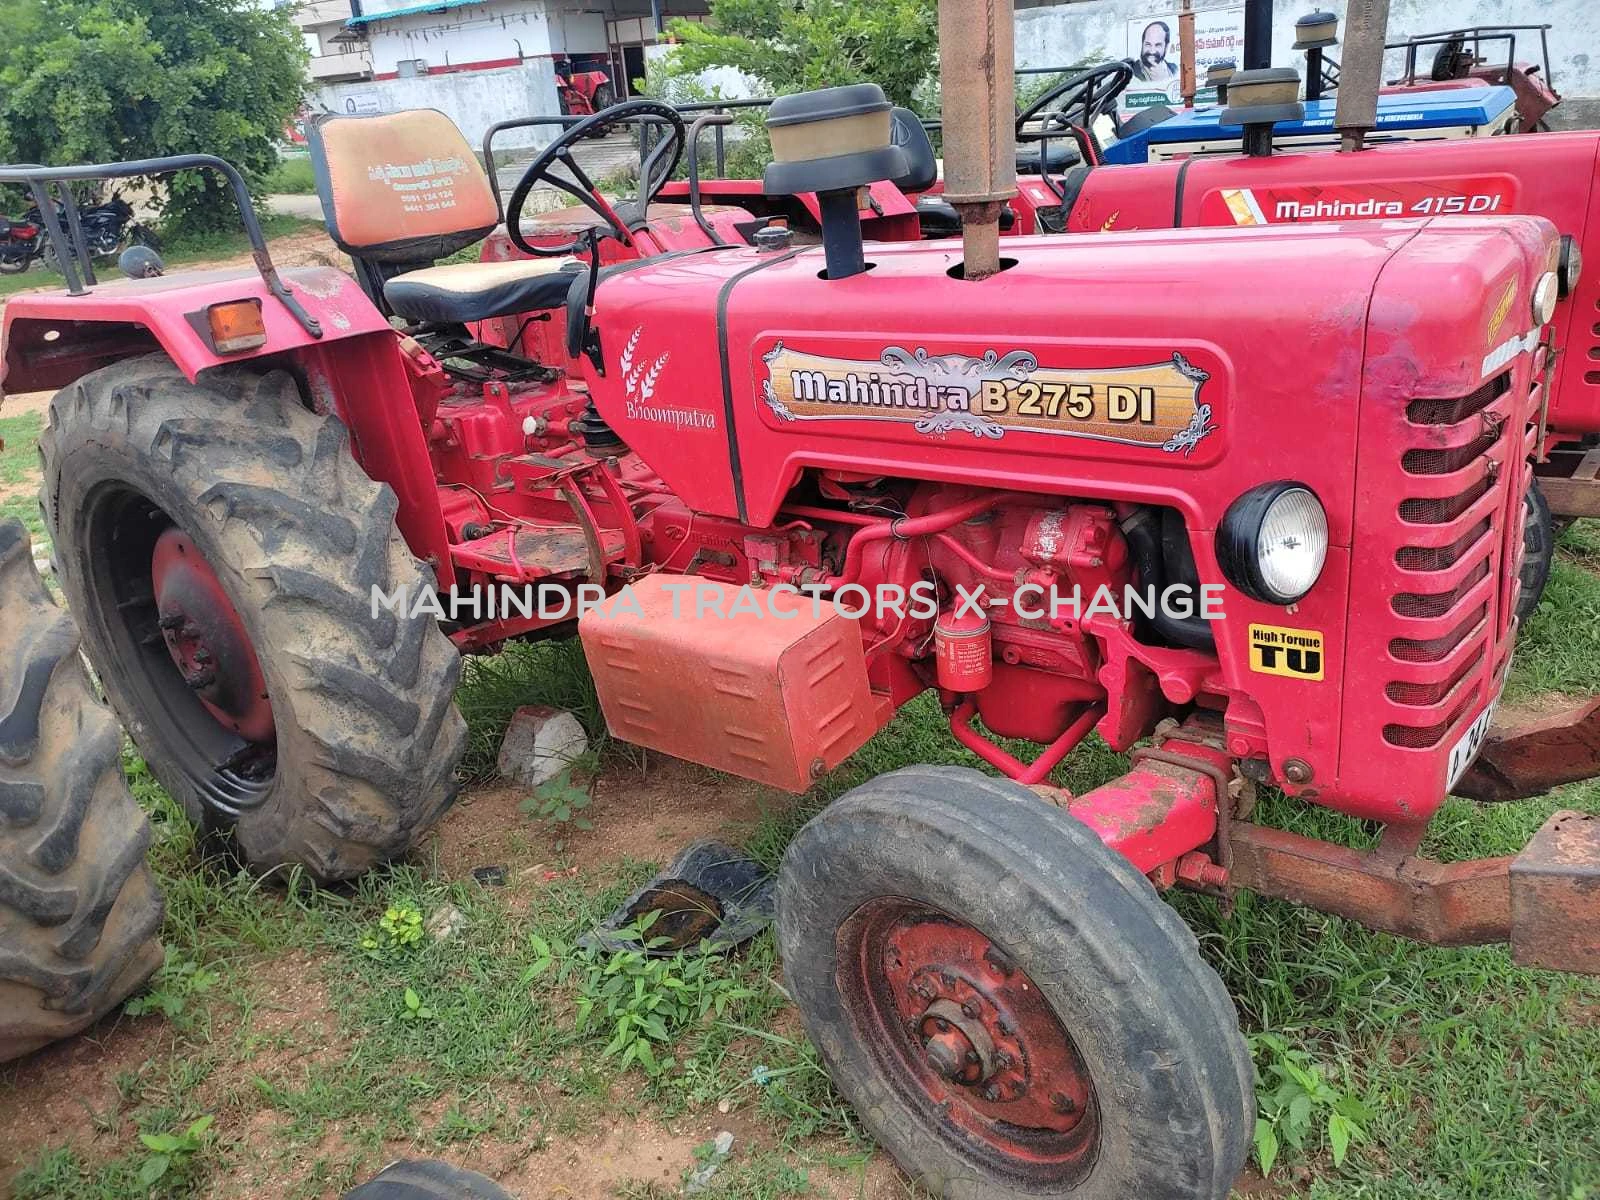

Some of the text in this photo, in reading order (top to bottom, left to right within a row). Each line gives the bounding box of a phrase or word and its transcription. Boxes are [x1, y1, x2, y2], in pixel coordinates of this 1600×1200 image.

[1275, 194, 1501, 219] Mahindra 415 DI
[790, 369, 1154, 423] Mahindra B 275 DI
[626, 398, 716, 431] Bhoomiputra
[1253, 629, 1320, 648] High Torque
[1253, 643, 1321, 674] TU
